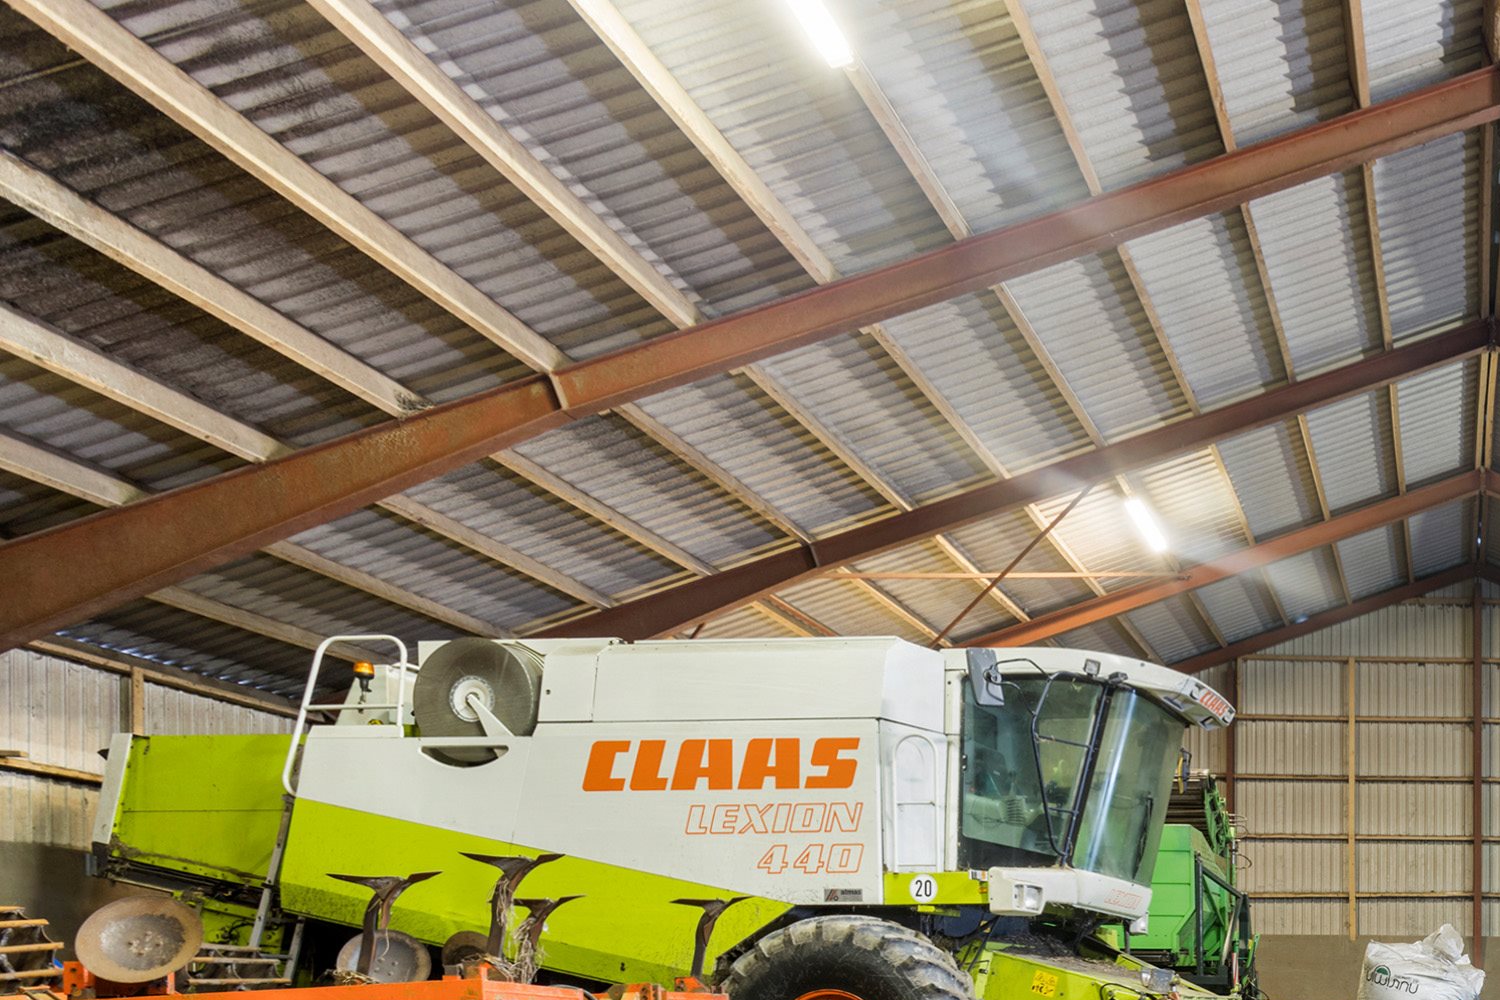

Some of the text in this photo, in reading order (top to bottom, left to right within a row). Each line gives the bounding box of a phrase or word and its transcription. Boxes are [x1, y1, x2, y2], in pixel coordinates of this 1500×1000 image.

[582, 737, 861, 792] CLAAS
[684, 802, 864, 835] LEXION
[757, 843, 865, 875] 440
[915, 879, 932, 898] 20
